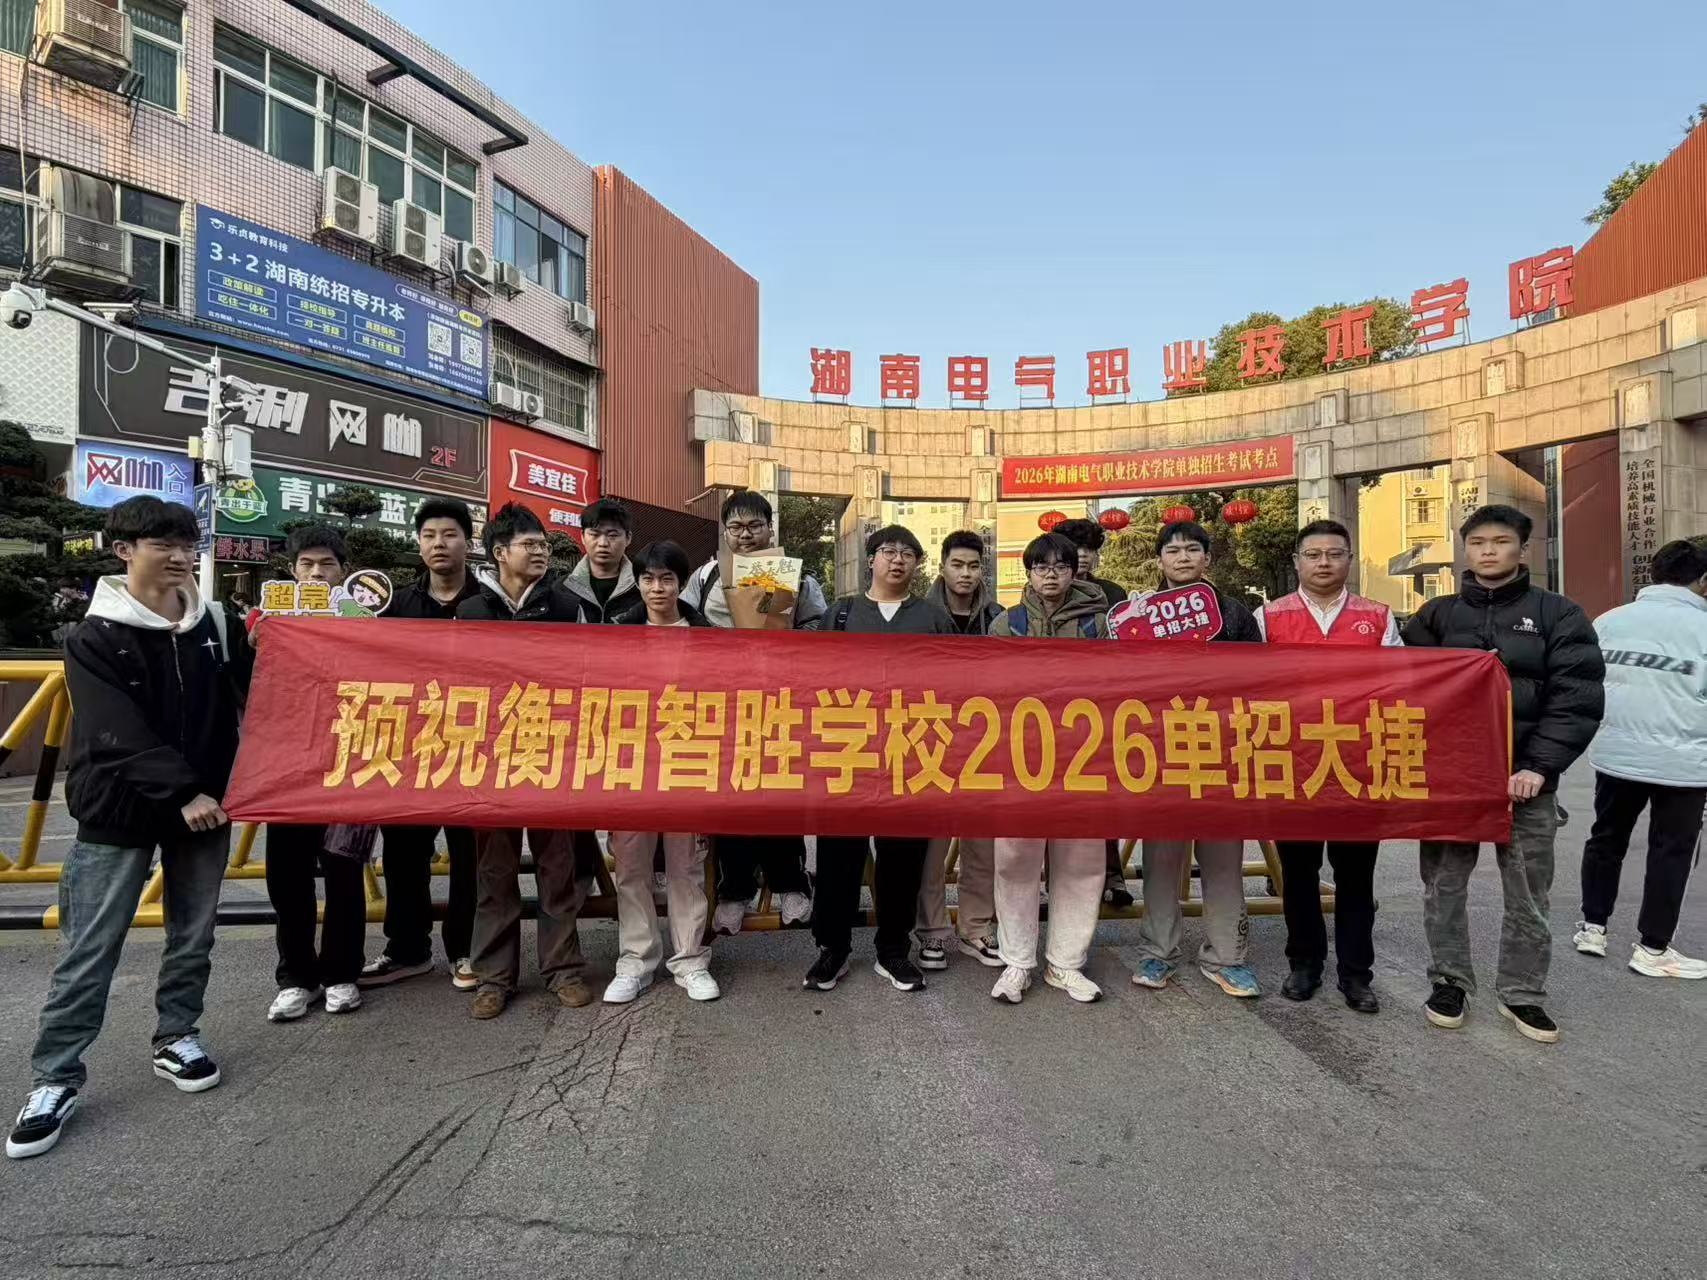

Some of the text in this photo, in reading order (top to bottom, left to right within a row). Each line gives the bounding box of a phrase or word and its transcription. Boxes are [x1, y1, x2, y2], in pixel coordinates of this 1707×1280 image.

[227, 224, 289, 253] 乐贞教育科技
[810, 246, 1575, 400] 湖南电气职业技术学院
[86, 451, 165, 492] 网咖
[430, 445, 457, 468] 2F
[1014, 447, 1279, 485] 2026年湖南电气职业技术学院单独招生考试考点
[528, 463, 577, 495] 美宜佳
[1146, 591, 1205, 624] 2026
[1152, 612, 1210, 638] 单招大捷
[323, 679, 1429, 801] 预祝衡阳智胜学校2026单招大捷
